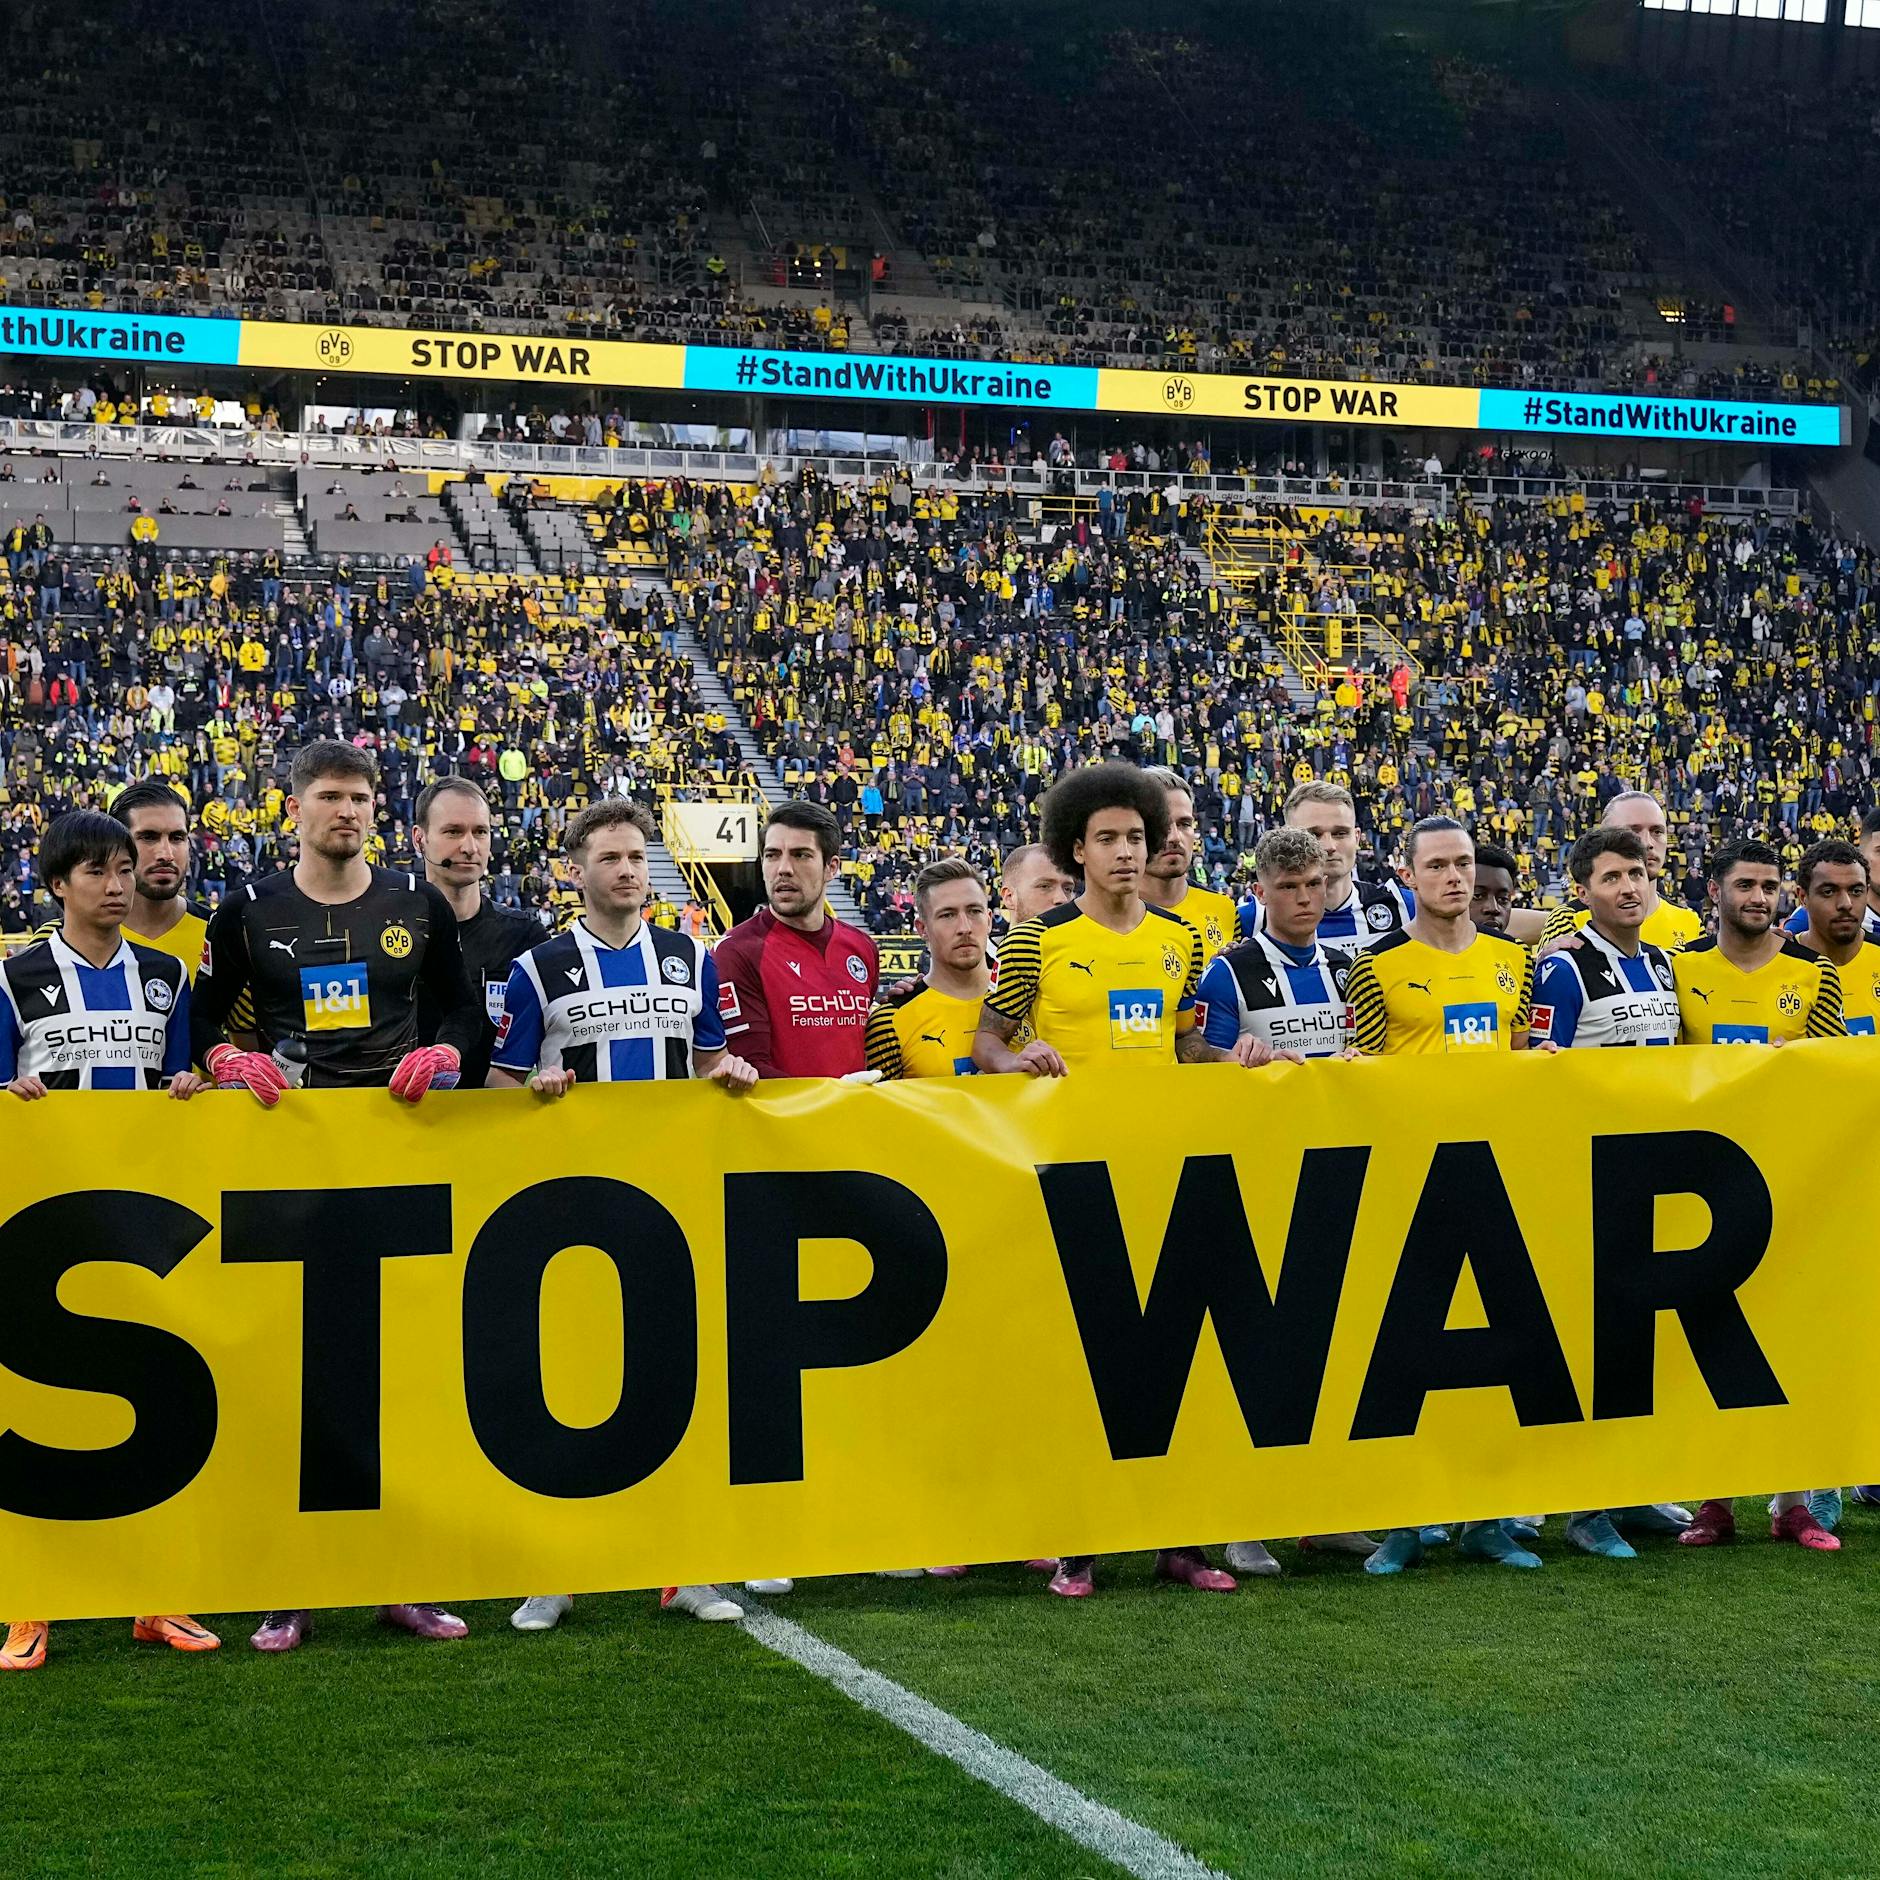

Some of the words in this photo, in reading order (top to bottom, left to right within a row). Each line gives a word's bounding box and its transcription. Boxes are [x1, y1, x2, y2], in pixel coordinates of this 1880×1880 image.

[321, 333, 349, 356] BVB
[411, 339, 501, 370] STOP
[512, 344, 591, 375] WAR
[736, 355, 1051, 400] #StandWithUkraine
[1167, 379, 1191, 401] BVB
[1244, 384, 1321, 413] STOP
[1331, 388, 1398, 417] WAR
[1524, 397, 1797, 437] #StandWithUkraine
[716, 816, 746, 843] 41
[386, 929, 409, 948] BVB
[1207, 924, 1222, 941] BVB
[1165, 954, 1180, 972] BVB
[1498, 972, 1515, 987] BVB
[308, 979, 361, 1014] 1&1
[567, 992, 688, 1023] SCHÜCO
[1779, 993, 1800, 1009] BVB
[572, 1021, 620, 1037] Fenster
[625, 1017, 650, 1030] und
[792, 1015, 834, 1027] Fenster
[837, 1013, 856, 1026] und
[1114, 1003, 1158, 1033] 1&1
[1269, 1011, 1347, 1036] SCHÜC
[1615, 1023, 1651, 1036] Fenster
[1653, 1020, 1667, 1031] und
[44, 1019, 164, 1048] SCHÜCO
[1272, 1037, 1312, 1050] Fenster
[1316, 1033, 1335, 1046] und
[1448, 1016, 1492, 1046] 1&1
[50, 1047, 101, 1062] Fenster
[106, 1046, 131, 1059] und
[0, 1170, 948, 1521] STOP
[1034, 1130, 1789, 1461] WAR
